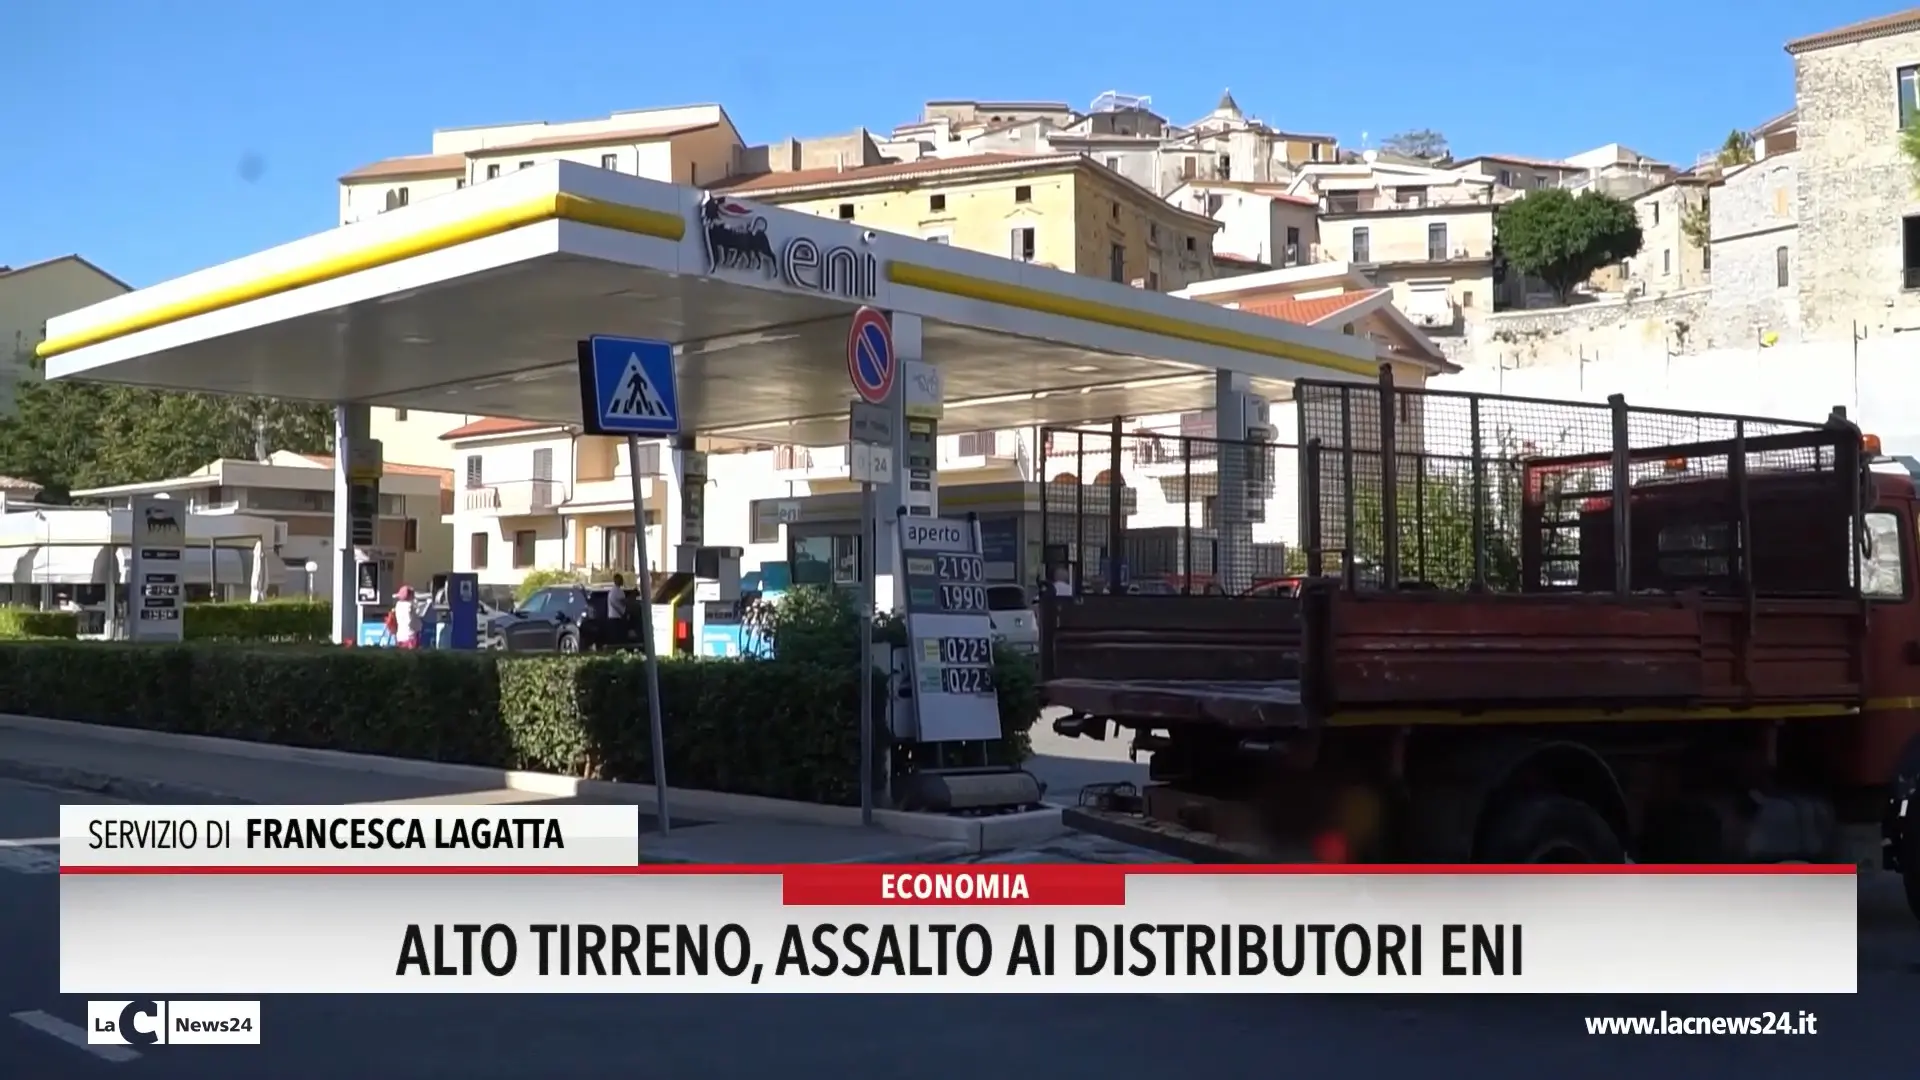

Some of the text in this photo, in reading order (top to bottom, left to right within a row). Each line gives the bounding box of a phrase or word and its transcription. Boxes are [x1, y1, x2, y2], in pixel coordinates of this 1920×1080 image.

[782, 230, 877, 298] eni
[874, 457, 887, 472] 24
[908, 524, 960, 545] aperto
